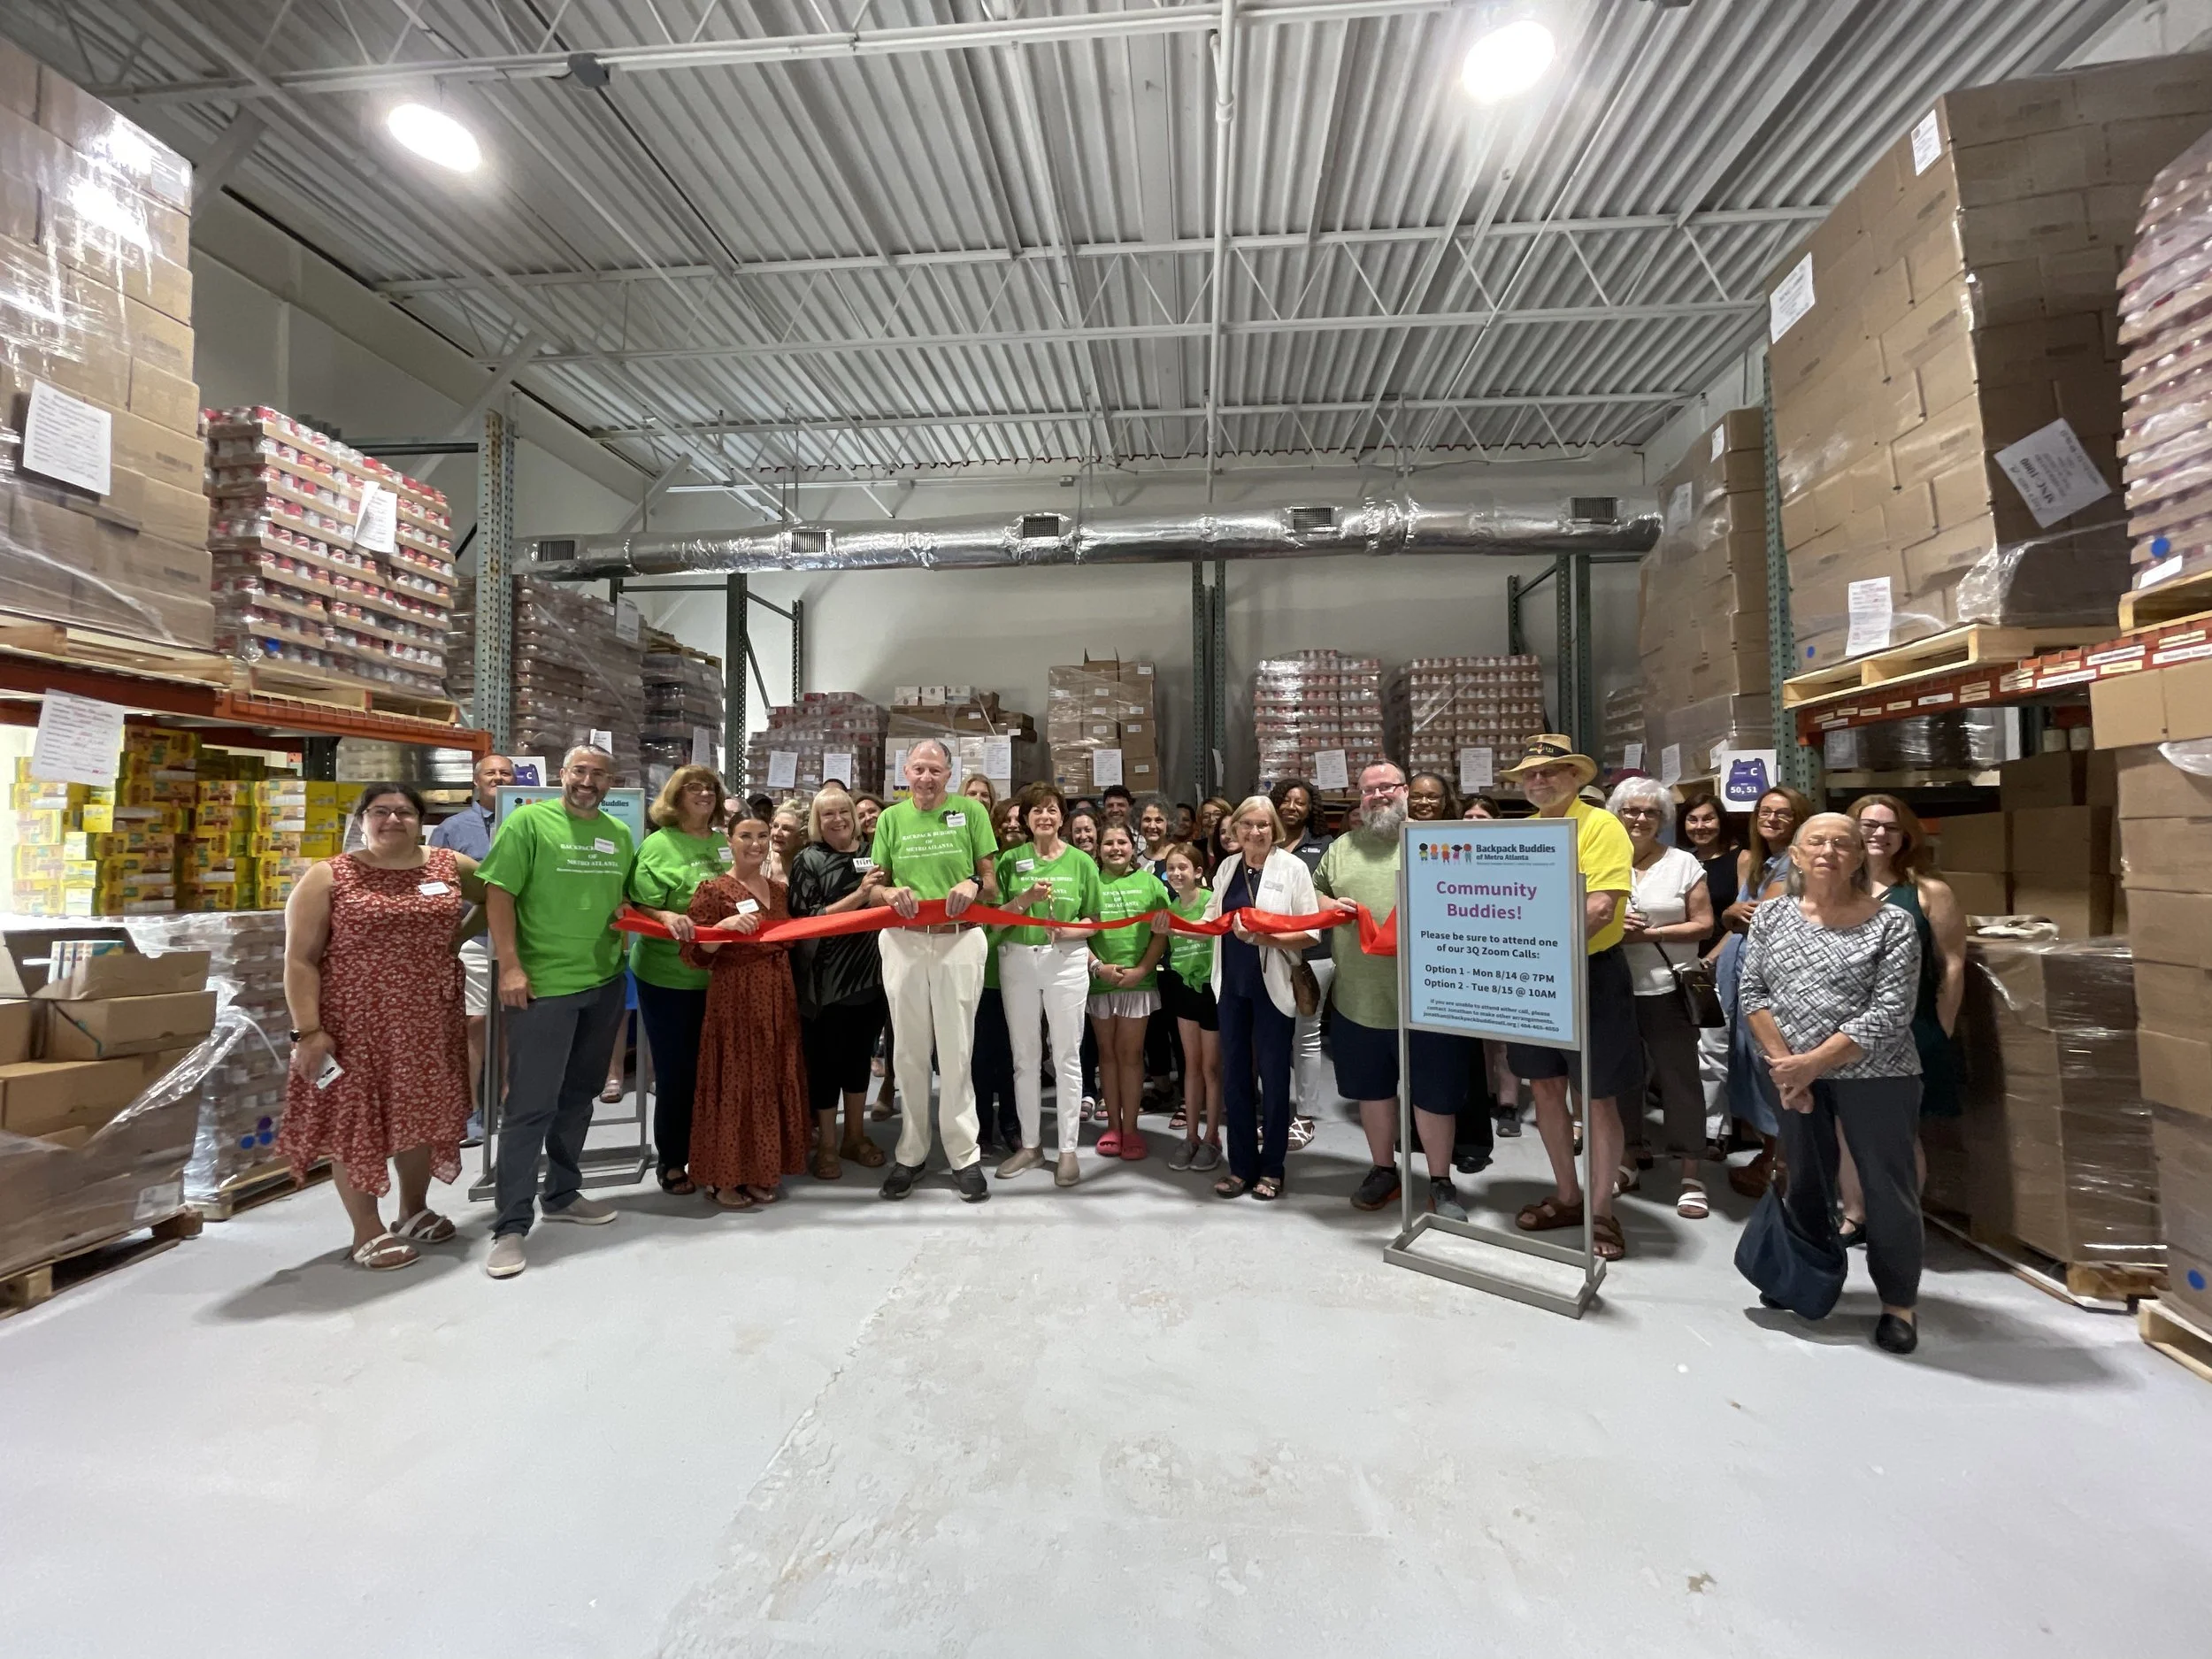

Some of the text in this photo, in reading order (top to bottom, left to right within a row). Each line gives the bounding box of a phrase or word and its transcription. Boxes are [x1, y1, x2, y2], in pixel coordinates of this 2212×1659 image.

[1751, 768, 1758, 776] C
[1476, 844, 1555, 854] Backpack Buddies
[1436, 881, 1537, 900] Community
[1447, 903, 1522, 920] Buddies!
[1421, 930, 1450, 940] Please
[1453, 932, 1464, 940] be
[1502, 937, 1536, 945] attend
[1538, 939, 1558, 947] one
[1466, 946, 1480, 956] 3Q
[1482, 947, 1509, 957] Zoom
[1512, 949, 1540, 959] Calls:
[1425, 964, 1457, 974] Option
[1472, 968, 1493, 977] Mon
[1495, 970, 1517, 980] 8/14
[1520, 972, 1530, 982] @
[1533, 974, 1554, 983] 7PM
[1424, 978, 1455, 989] Option
[1471, 983, 1489, 992] Tue
[1492, 985, 1513, 994] 8/15
[1516, 987, 1526, 997] @
[1529, 988, 1556, 999] 10AM
